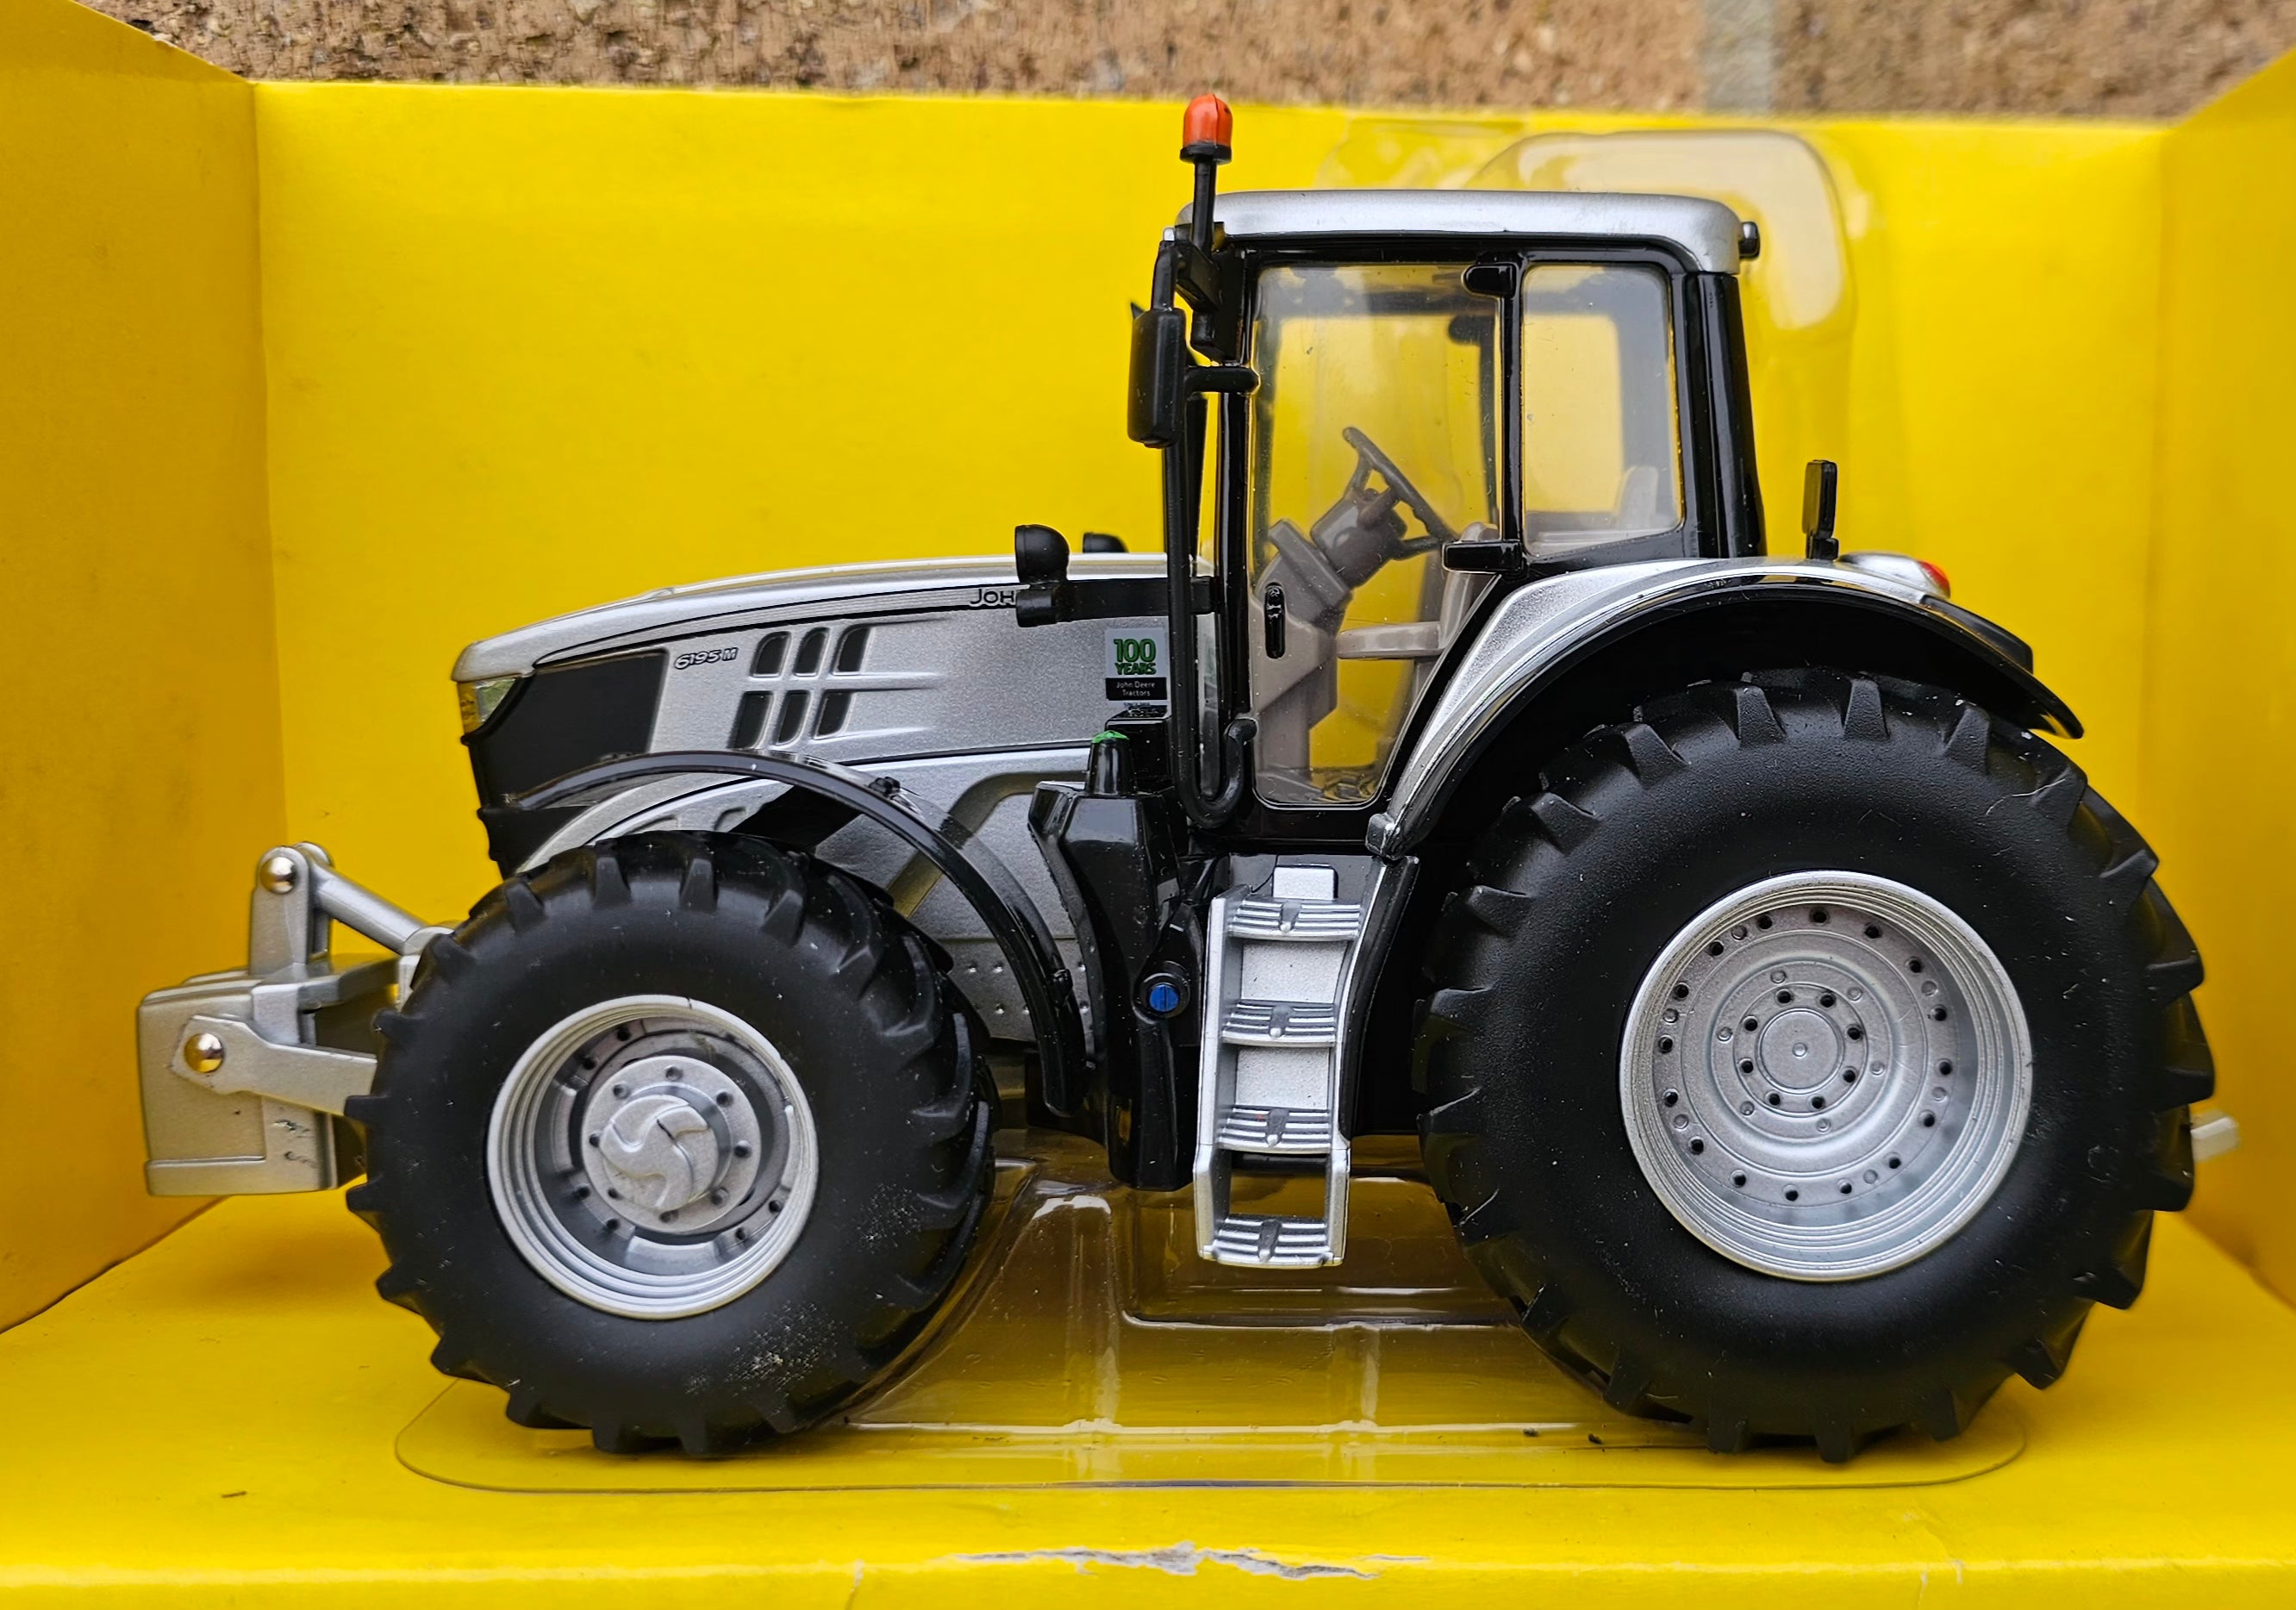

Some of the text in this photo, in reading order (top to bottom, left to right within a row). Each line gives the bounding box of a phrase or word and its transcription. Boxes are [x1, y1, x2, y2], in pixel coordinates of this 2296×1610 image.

[970, 588, 1015, 604] JOH
[1113, 639, 1157, 663] 100
[1114, 663, 1157, 675] YEARS
